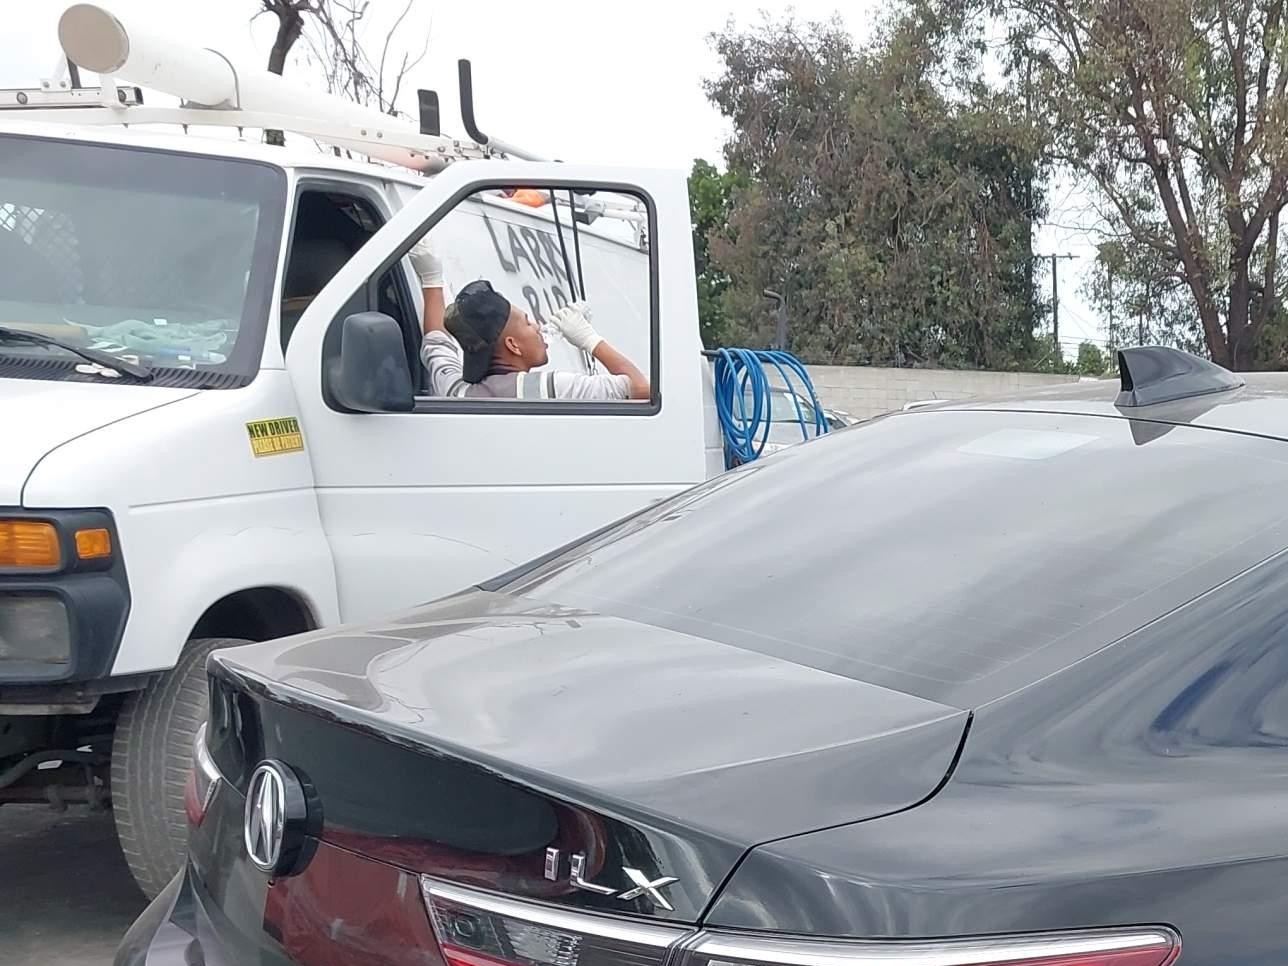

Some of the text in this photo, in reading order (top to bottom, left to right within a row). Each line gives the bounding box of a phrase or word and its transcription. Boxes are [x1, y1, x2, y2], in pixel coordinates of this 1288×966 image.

[247, 419, 300, 438] NEW DRIVER
[544, 847, 680, 911] ILX
